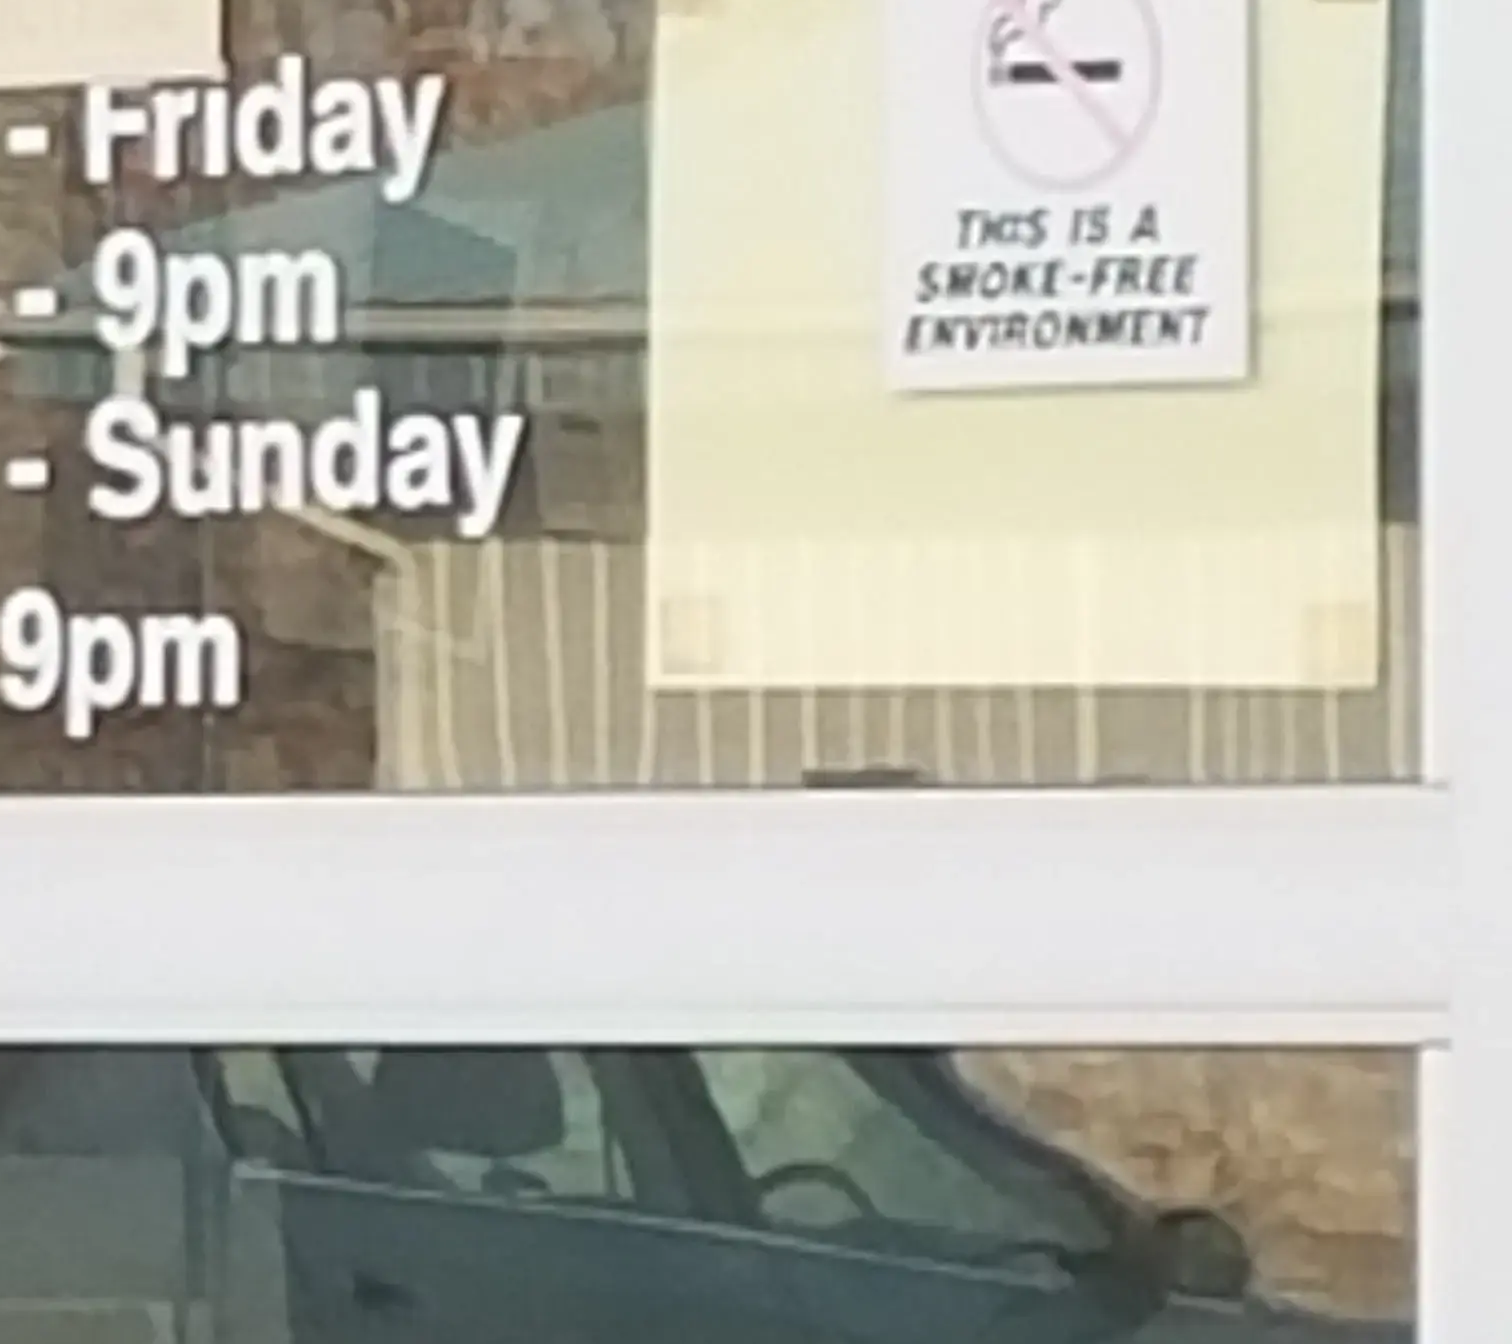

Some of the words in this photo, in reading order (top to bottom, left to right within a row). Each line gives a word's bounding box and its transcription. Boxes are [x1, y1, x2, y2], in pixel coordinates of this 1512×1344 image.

[83, 56, 446, 202] Friday
[956, 206, 1049, 250] THIS
[1068, 204, 1112, 246] IS
[1129, 202, 1161, 244] A
[92, 228, 339, 378] 9pm
[914, 254, 1199, 305] SMOKE-FREE
[903, 306, 1212, 355] ENVIRONMENT
[84, 387, 525, 539] Sunday
